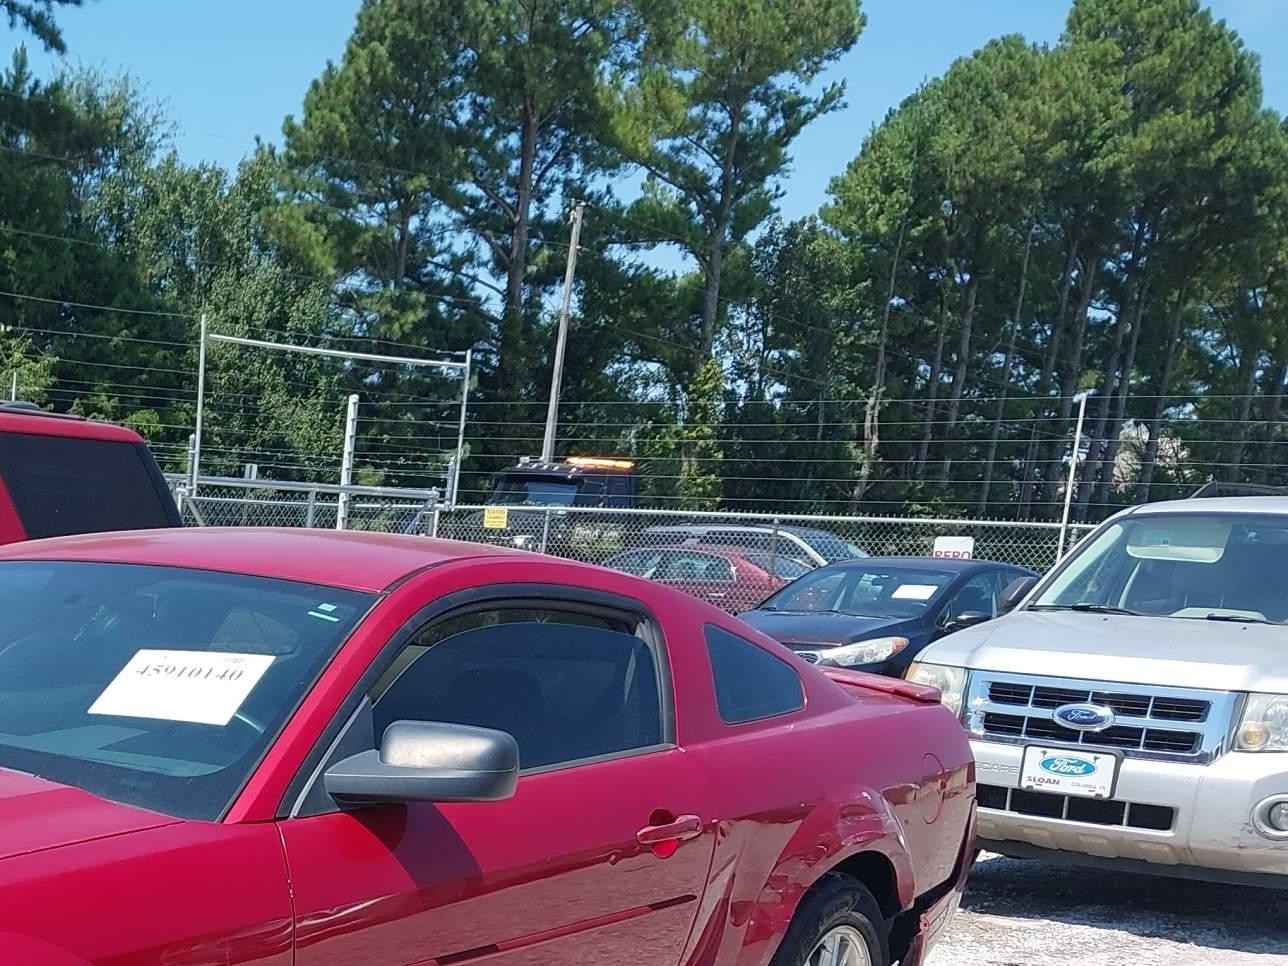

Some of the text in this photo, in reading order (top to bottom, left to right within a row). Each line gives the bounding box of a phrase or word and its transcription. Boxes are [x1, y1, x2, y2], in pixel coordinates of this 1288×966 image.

[974, 760, 1019, 775] SCAPE
[1049, 757, 1085, 775] Ford
[1026, 775, 1061, 786] SLOAN
